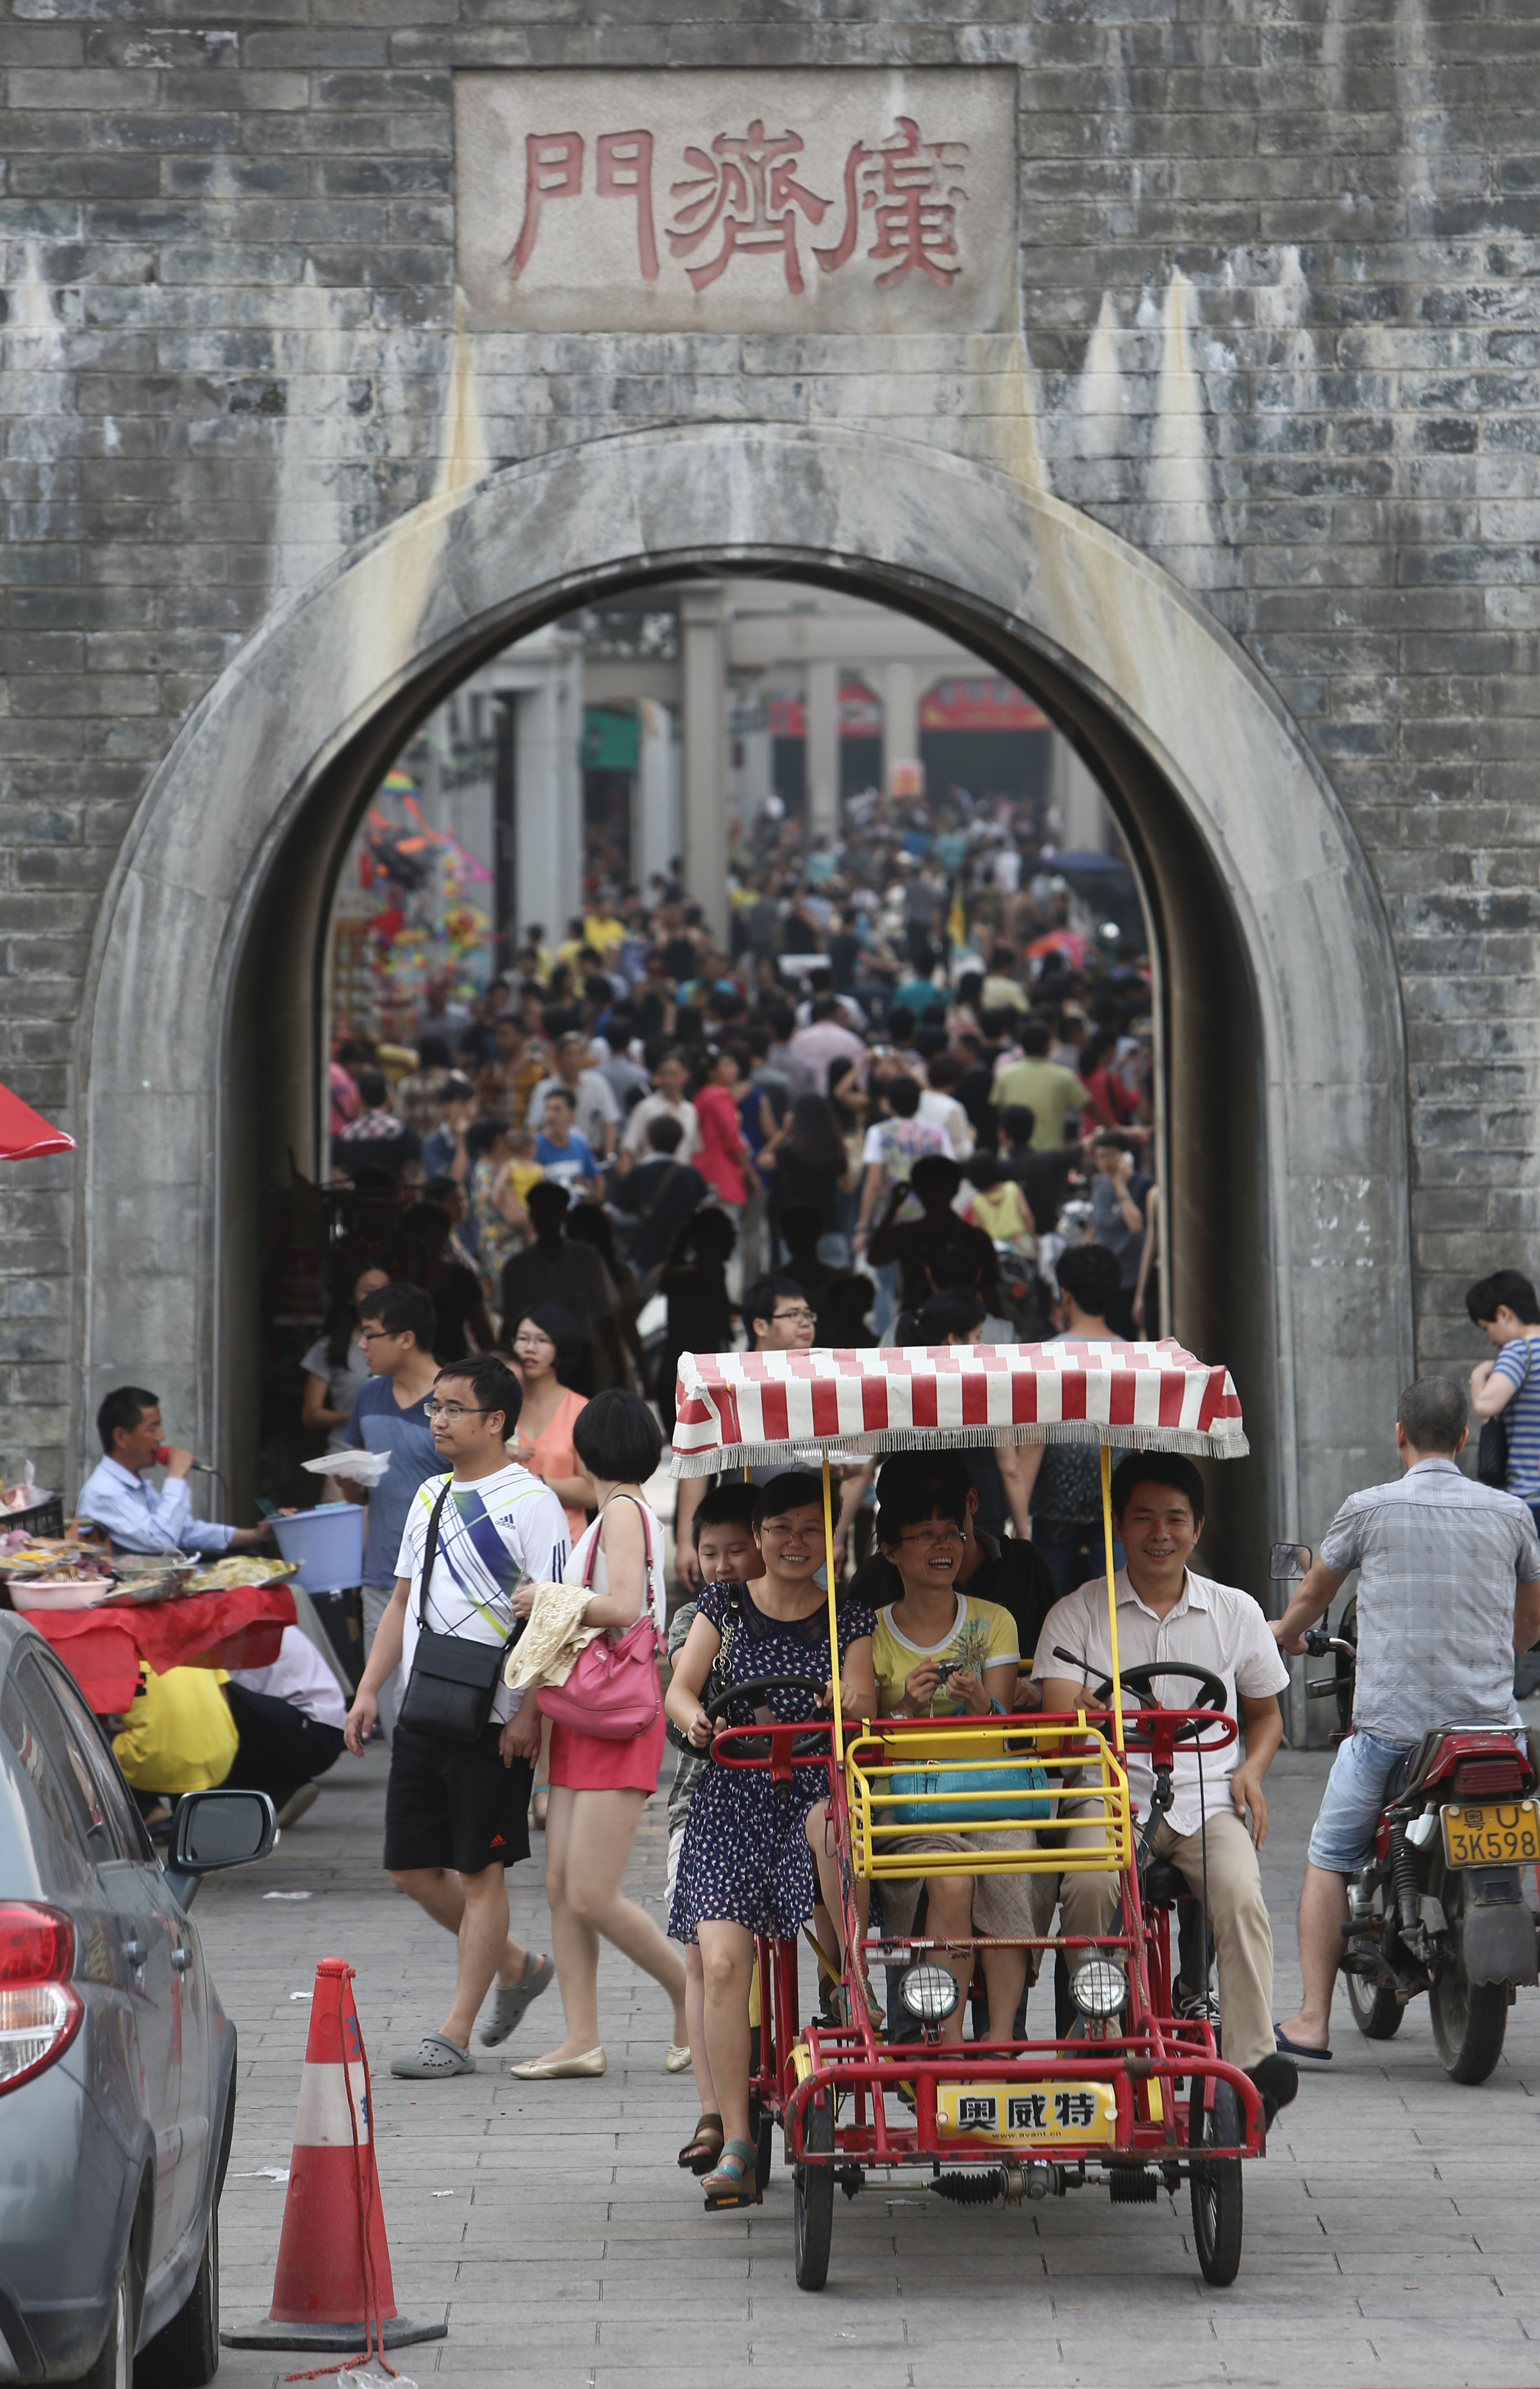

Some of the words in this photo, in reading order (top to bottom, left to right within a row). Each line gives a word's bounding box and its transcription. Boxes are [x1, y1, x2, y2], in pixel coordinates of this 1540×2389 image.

[1453, 1830, 1536, 1861] 3K598
[958, 2093, 1095, 2131] 奥威特
[992, 2131, 1062, 2139] www.avant.cn
